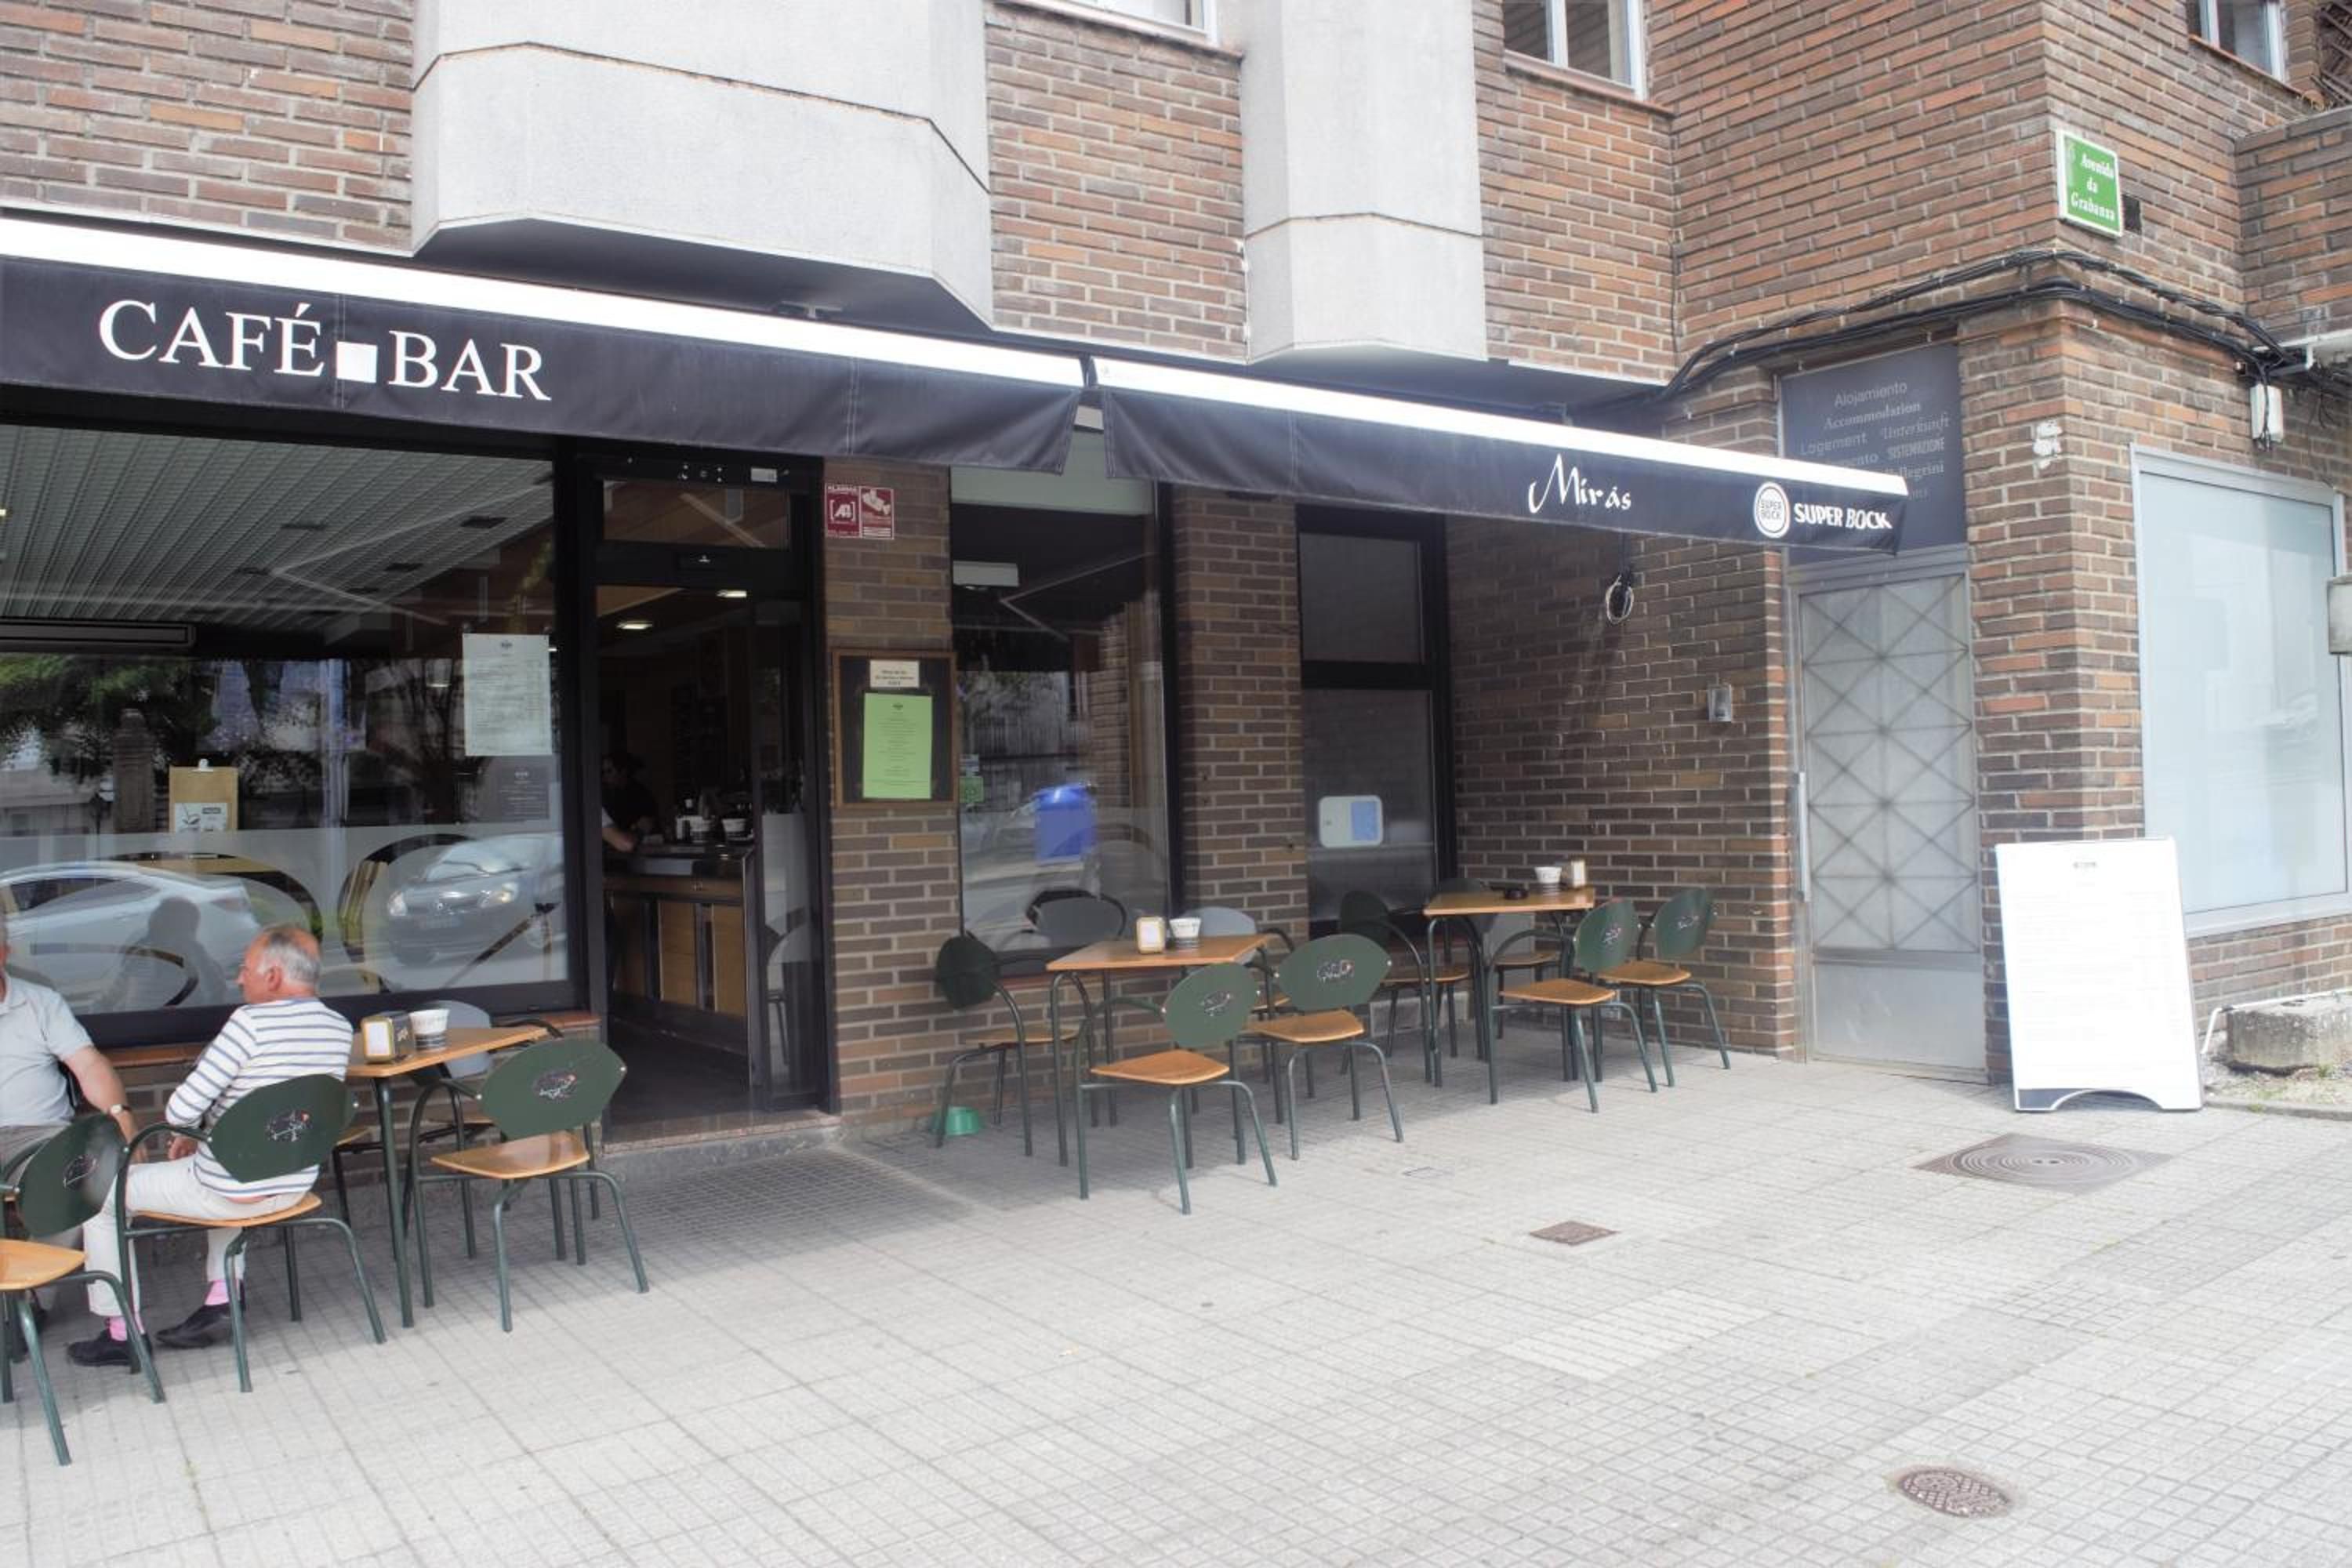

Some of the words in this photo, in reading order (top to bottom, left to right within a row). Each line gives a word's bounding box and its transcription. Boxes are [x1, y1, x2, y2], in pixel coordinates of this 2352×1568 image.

[98, 299, 325, 379] CAFÉ
[387, 330, 552, 401] BAR
[1527, 453, 1632, 514] Mirás
[1793, 503, 1843, 528] SUPER
[1845, 507, 1893, 530] BOCK
